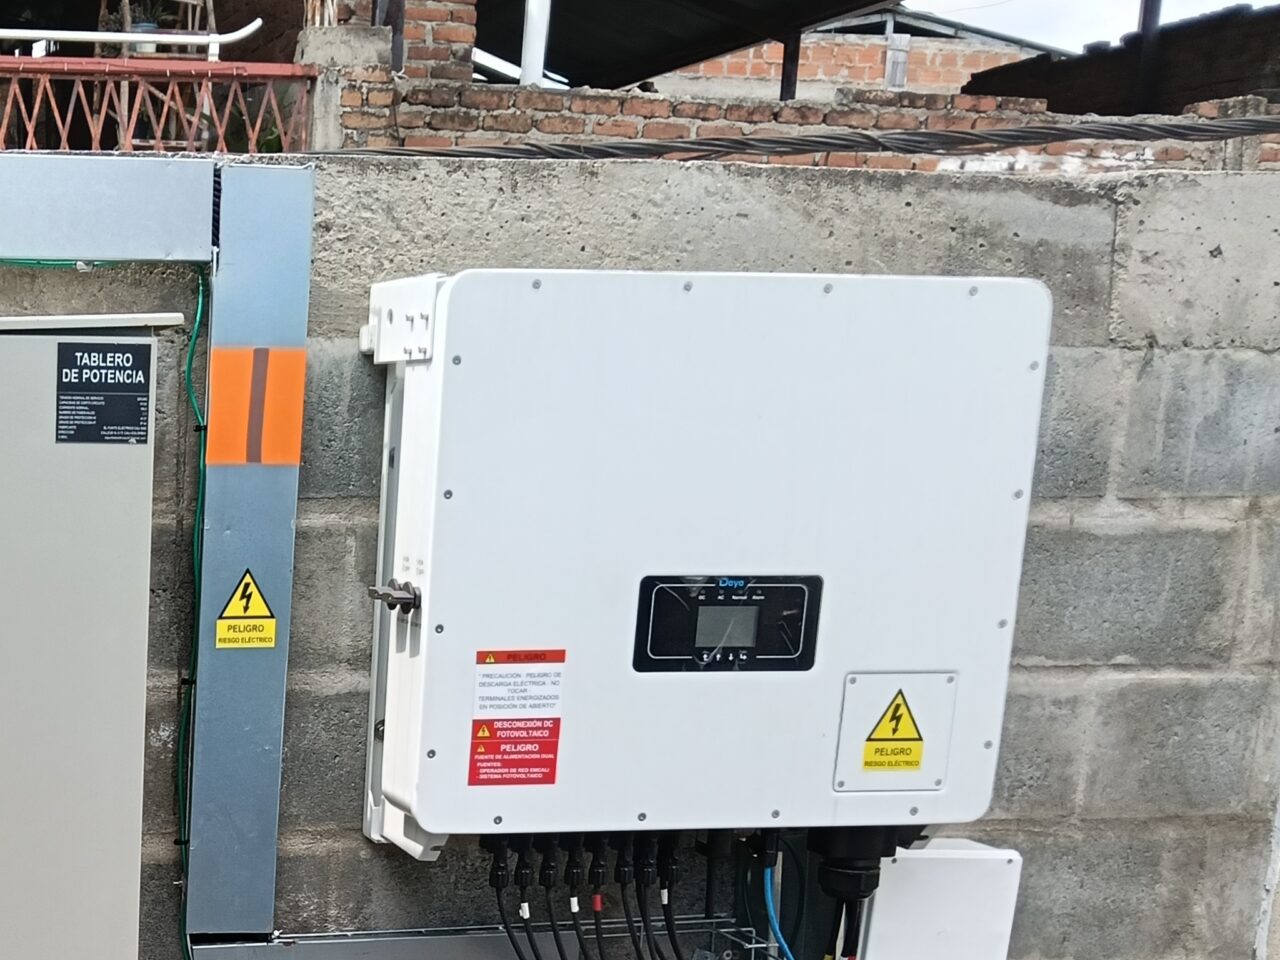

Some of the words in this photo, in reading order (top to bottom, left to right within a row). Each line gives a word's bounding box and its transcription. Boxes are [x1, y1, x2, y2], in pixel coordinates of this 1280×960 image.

[74, 352, 133, 367] TABLERO
[62, 369, 79, 382] DE
[82, 369, 145, 384] POTENCIA
[227, 624, 265, 633] PELIGRO
[543, 720, 554, 728] DC
[497, 730, 550, 738] FOTOVOLTAICO
[500, 743, 539, 752] PELIGRO
[874, 747, 912, 756] PELIGRO
